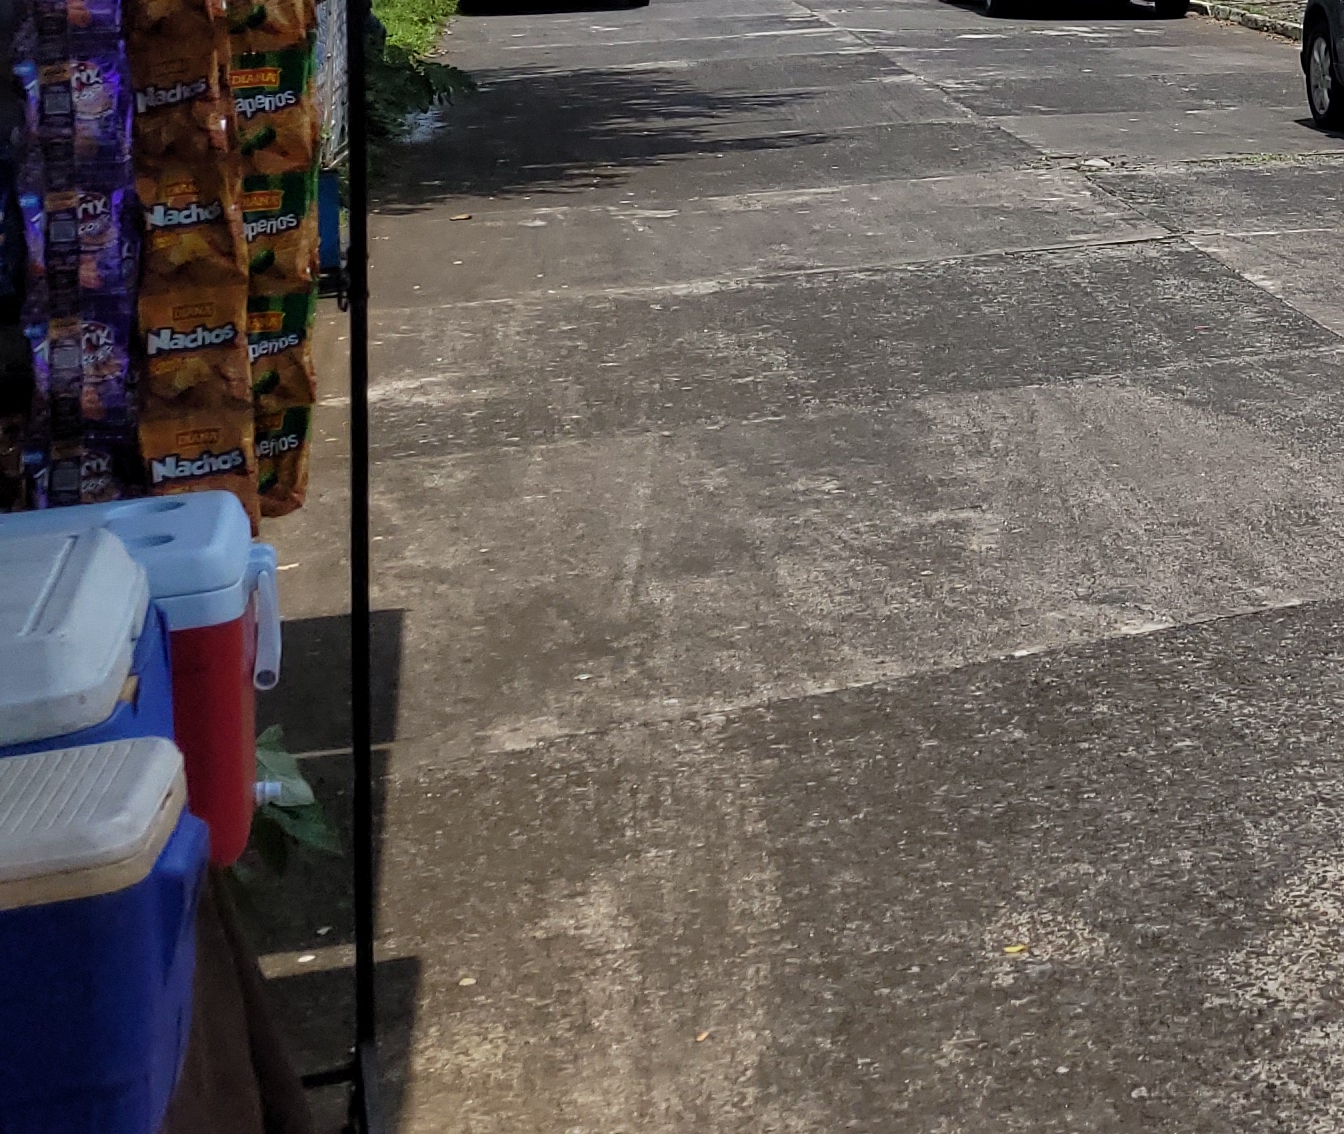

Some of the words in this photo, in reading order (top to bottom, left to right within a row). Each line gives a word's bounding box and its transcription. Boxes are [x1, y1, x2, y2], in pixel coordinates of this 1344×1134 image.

[235, 90, 297, 118] apeños
[147, 323, 236, 356] Nachos
[247, 333, 299, 362] peños
[151, 450, 244, 484] Nachos
